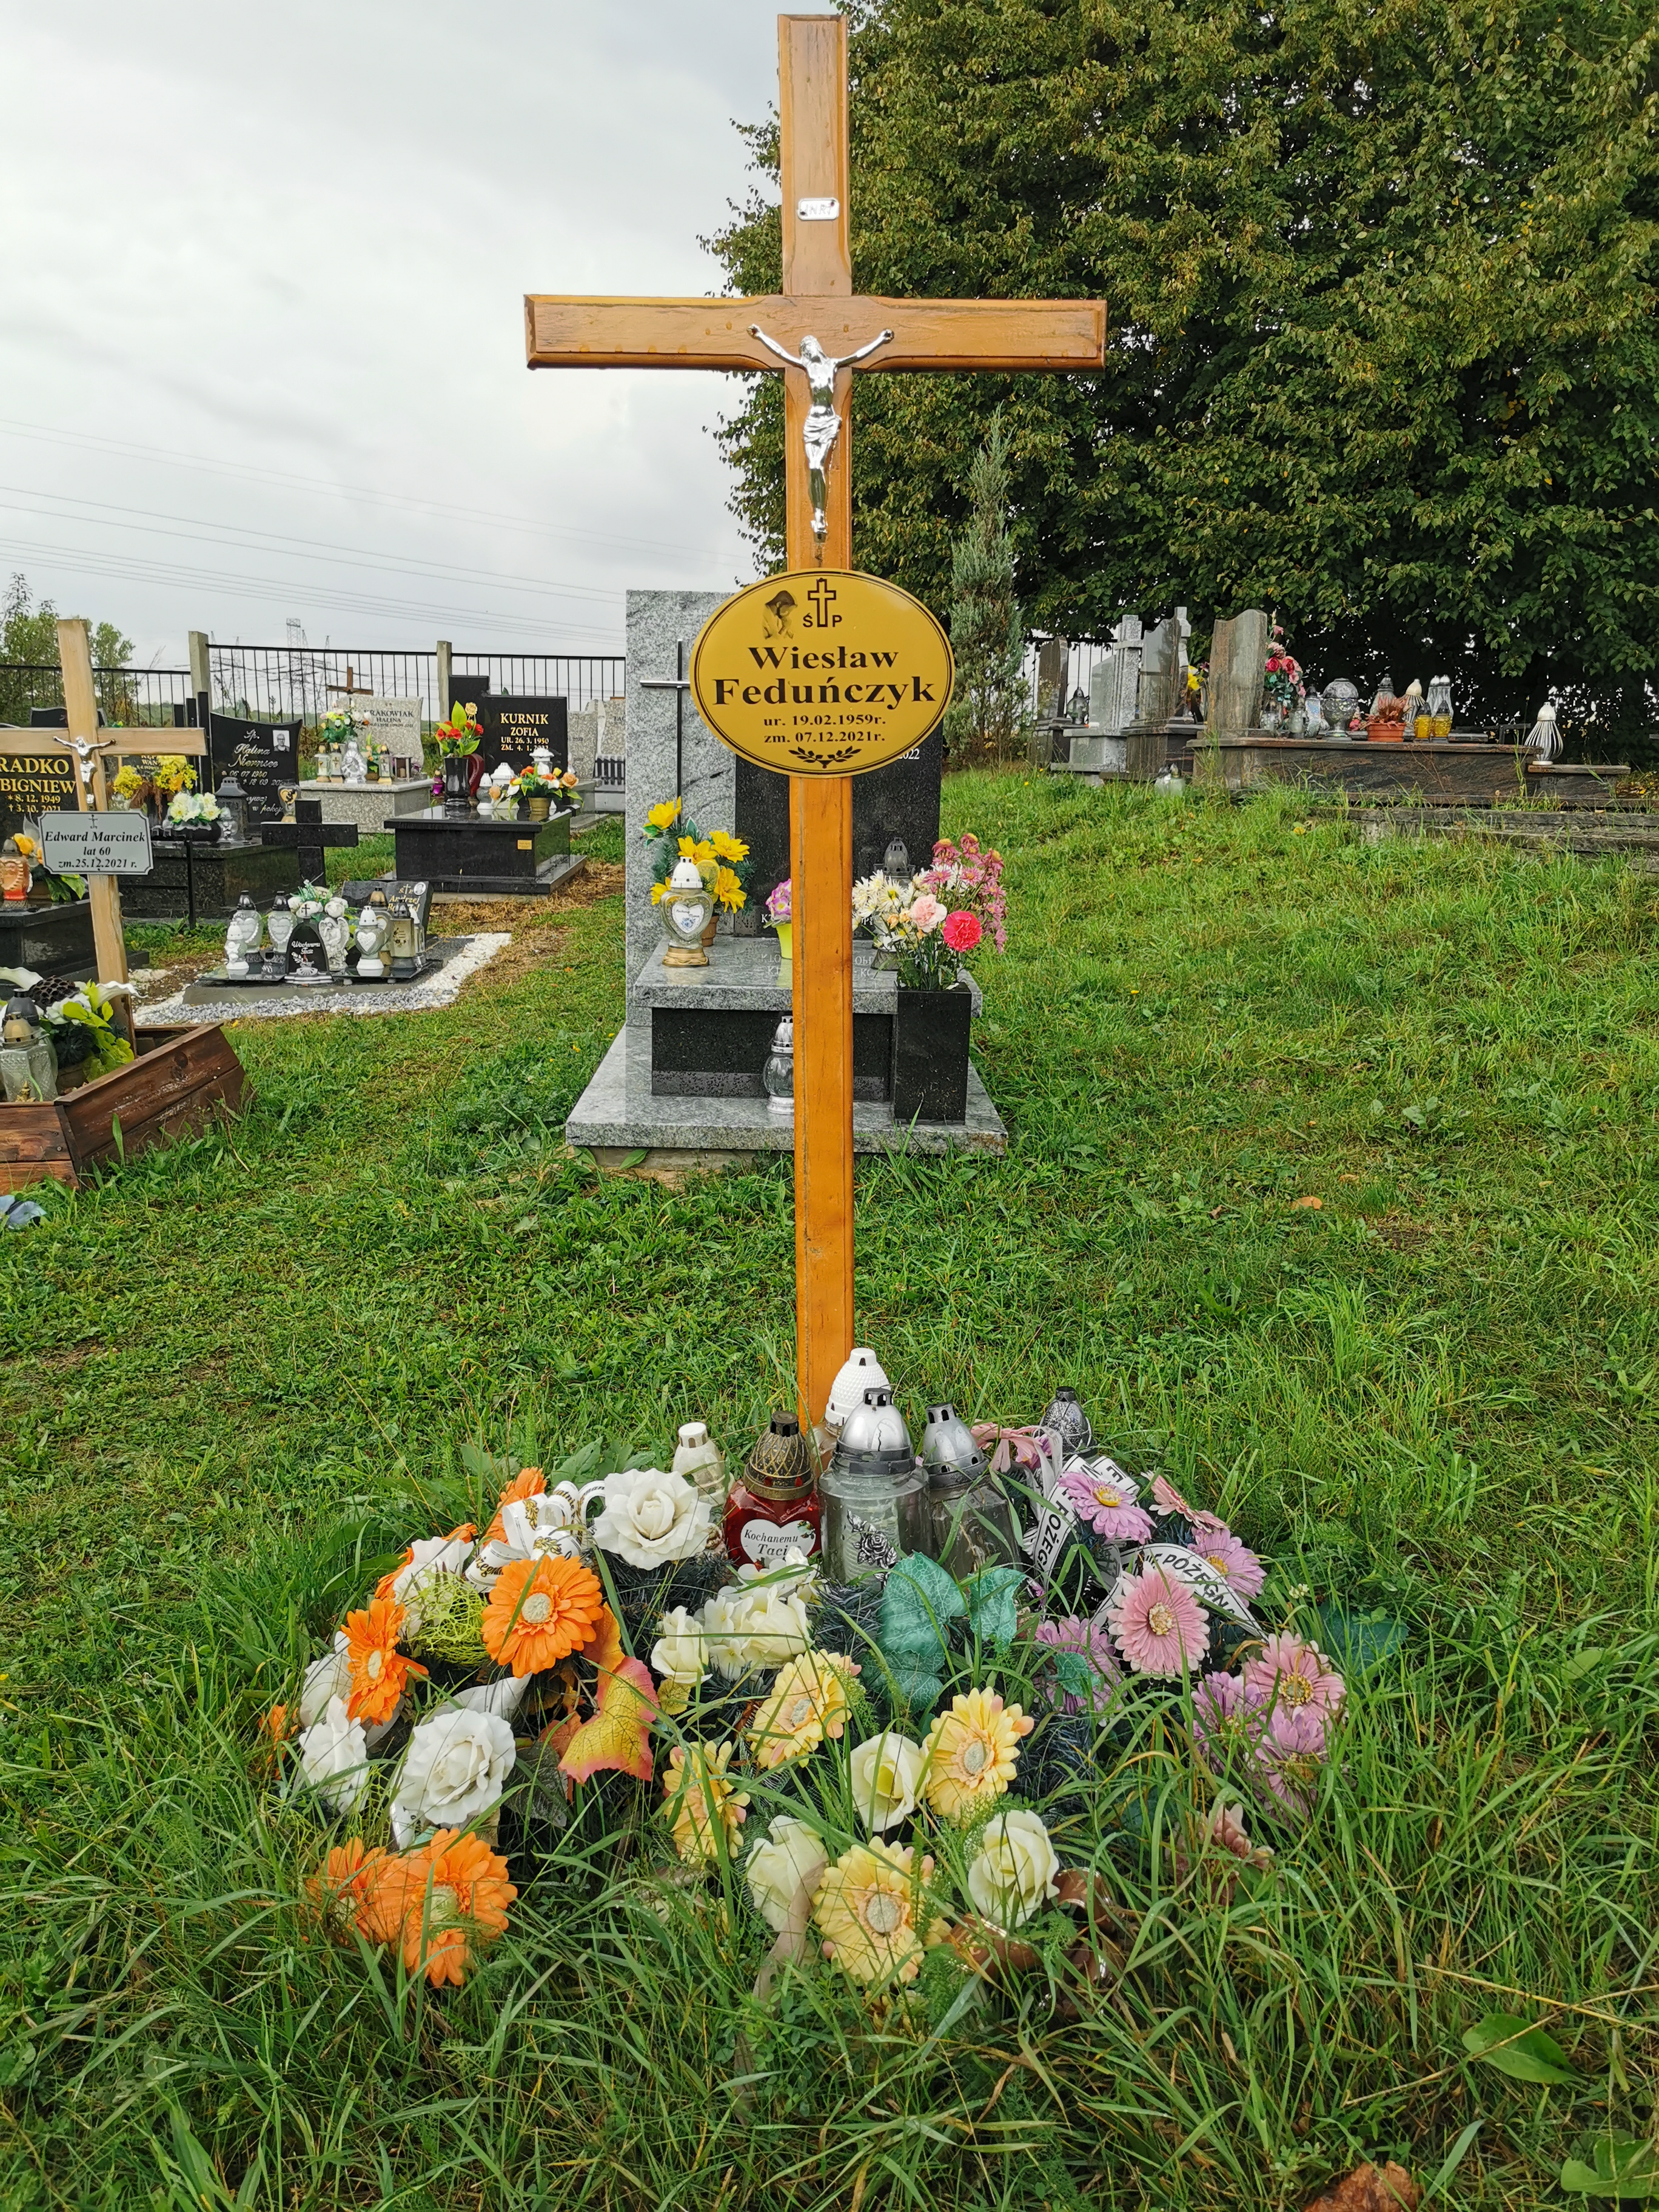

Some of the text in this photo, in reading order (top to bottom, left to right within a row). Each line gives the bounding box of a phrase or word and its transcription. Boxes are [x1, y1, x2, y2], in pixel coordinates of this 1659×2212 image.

[832, 614, 842, 628] P
[748, 646, 899, 670] Wiesław
[712, 675, 936, 709] Feduńczyk
[500, 712, 549, 725] KURNIK
[763, 714, 886, 726] ur. 19.02.1959r.
[510, 726, 539, 737] ZOFIA
[764, 731, 885, 743] zm. 07.12.2021r.
[26, 794, 39, 803] 12.
[41, 795, 61, 804] 1949
[45, 831, 145, 842] Edward Marcinek
[83, 846, 111, 856] lat 60
[744, 1529, 799, 1543] Kochanemu
[757, 1543, 802, 1557] Taci
